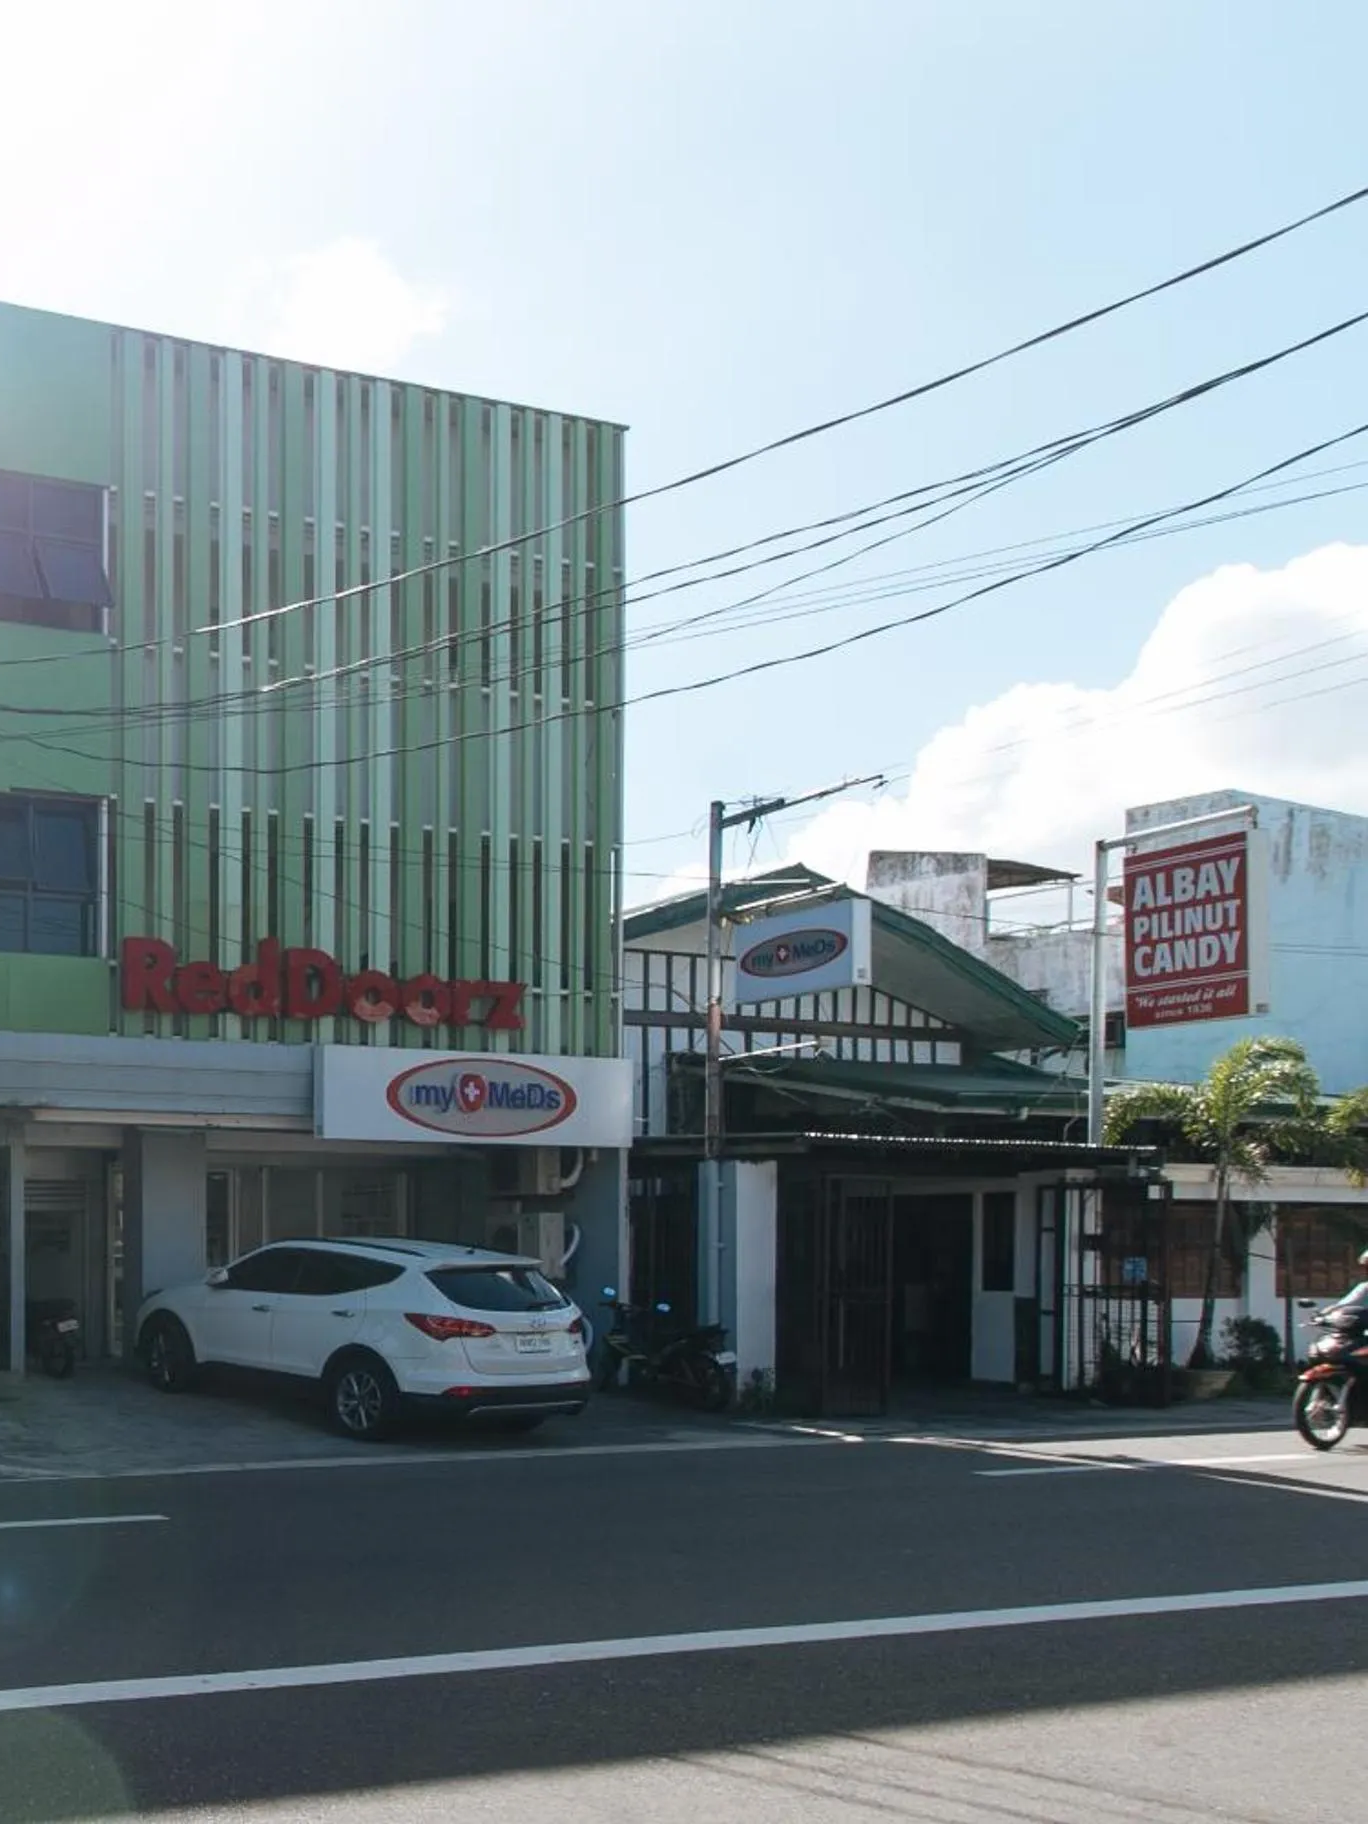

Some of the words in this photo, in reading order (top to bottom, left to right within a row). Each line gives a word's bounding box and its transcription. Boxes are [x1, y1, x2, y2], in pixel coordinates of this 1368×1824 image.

[1132, 857, 1241, 912] ALBAY
[1133, 899, 1241, 944] PILINUT
[1133, 930, 1241, 977] CANDY
[122, 935, 528, 1030] RedDoorz
[1157, 988, 1202, 1006] started
[1203, 987, 1215, 1000] it
[1216, 984, 1237, 999] all
[410, 1076, 456, 1114] my
[488, 1081, 561, 1110] MeDs
